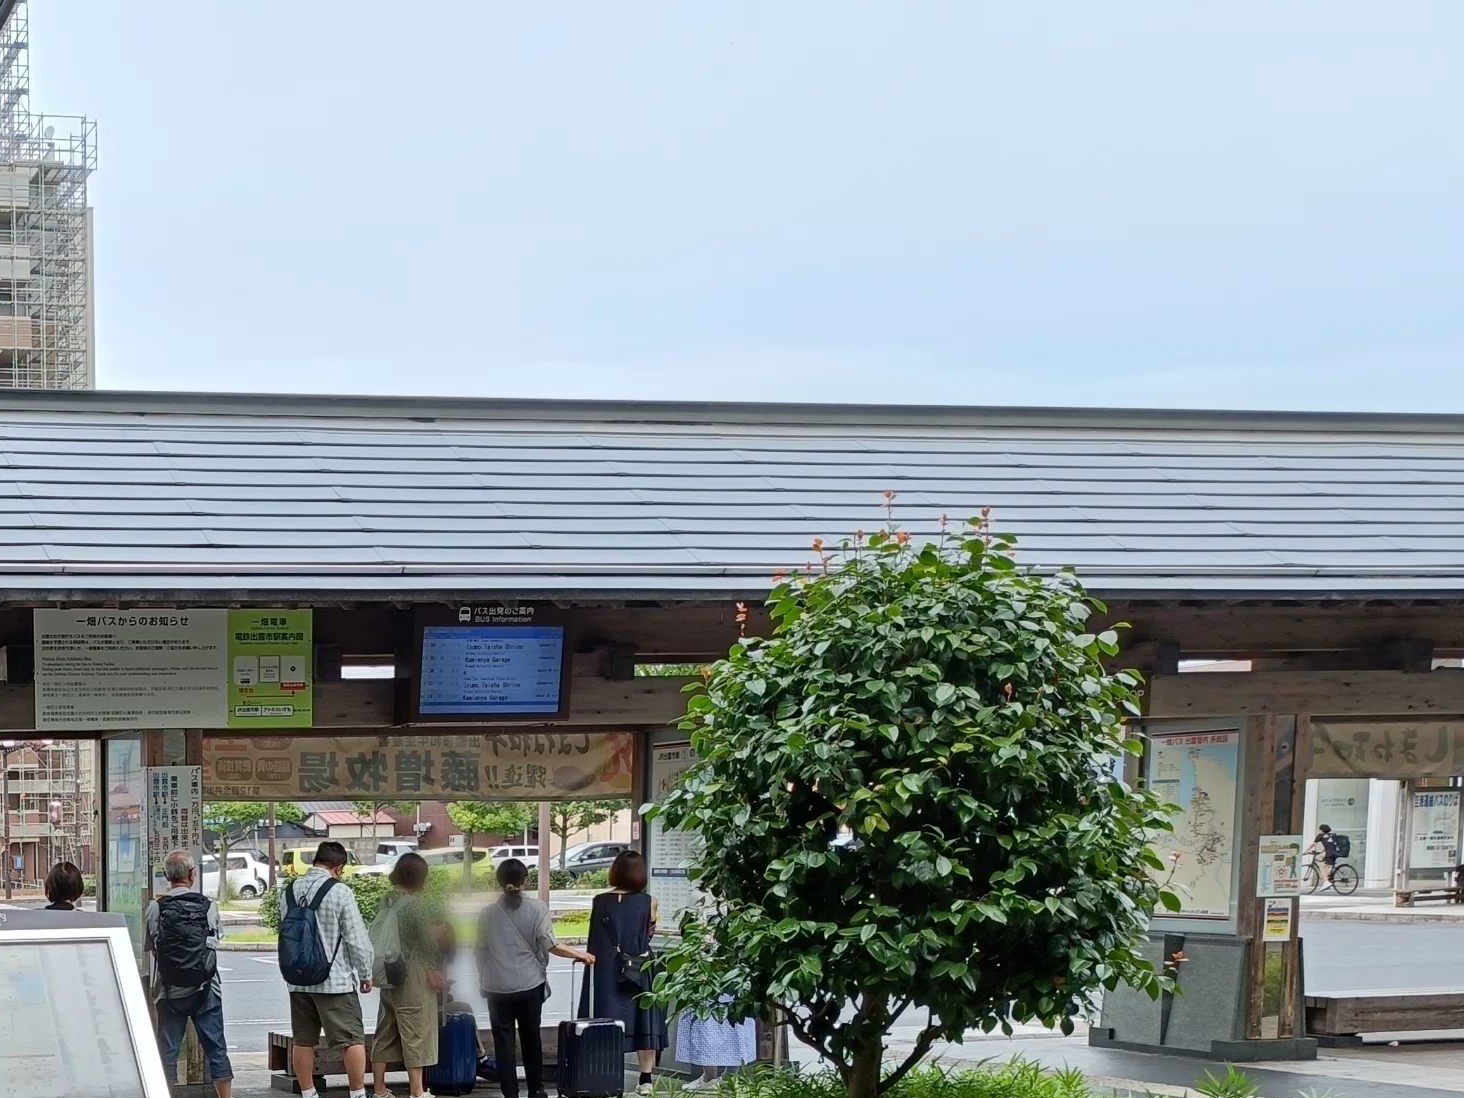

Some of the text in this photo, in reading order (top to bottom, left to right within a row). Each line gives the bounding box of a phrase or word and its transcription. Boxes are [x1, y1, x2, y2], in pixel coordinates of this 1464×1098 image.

[473, 607, 534, 616] バス出発のご案内
[76, 616, 189, 627] 一畑バスからのお知らせ
[252, 617, 287, 627] 一畑電車
[235, 632, 304, 641] 電鉄出雲市駅案内図
[170, 775, 179, 851] 乗車前に小銭をご用意下
